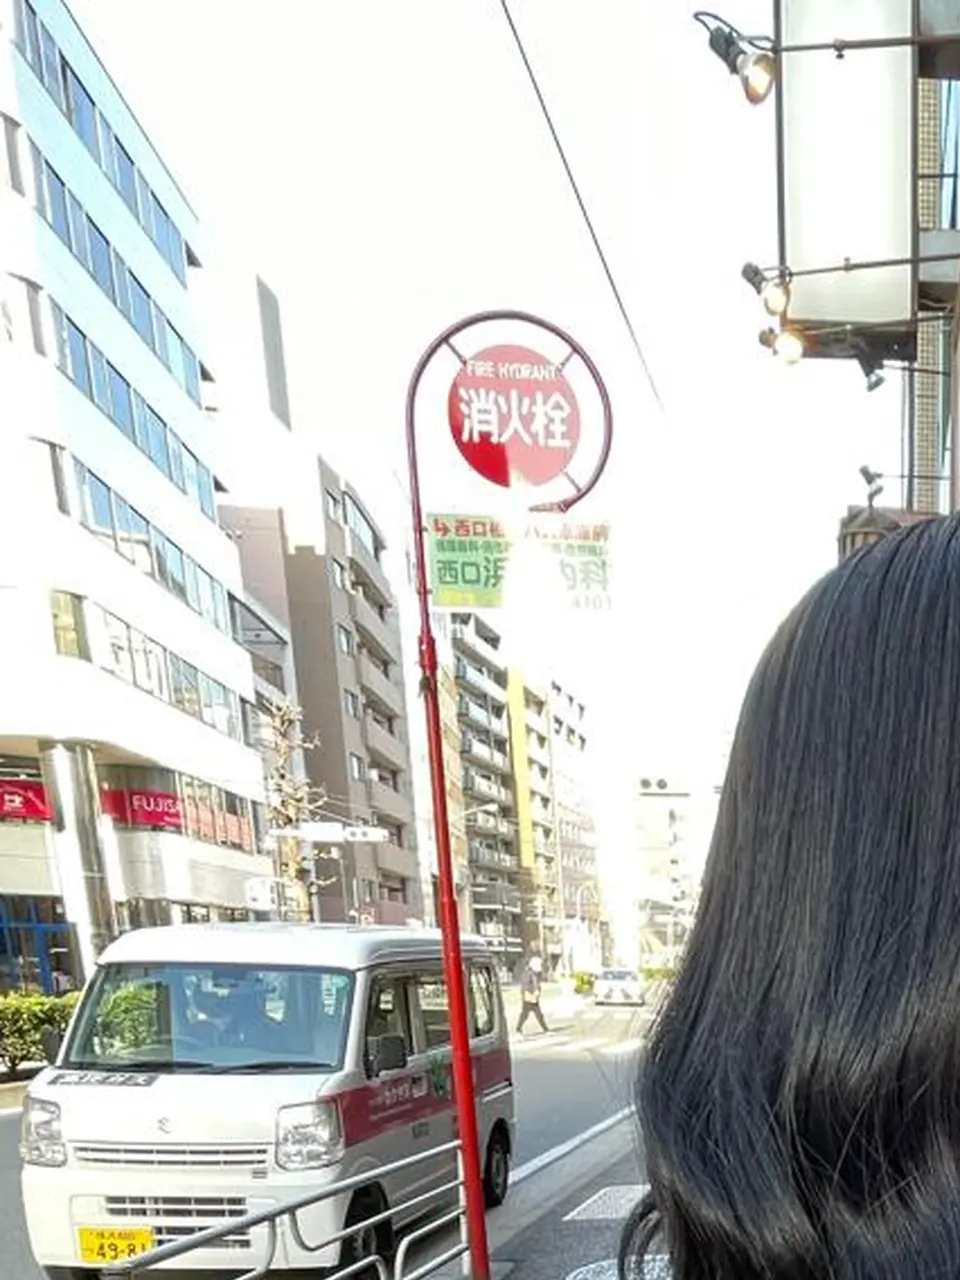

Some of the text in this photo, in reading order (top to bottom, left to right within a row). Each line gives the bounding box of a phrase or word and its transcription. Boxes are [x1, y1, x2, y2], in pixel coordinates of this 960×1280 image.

[466, 360, 562, 381] FIRE HYDRANT
[458, 387, 572, 448] 消火栓
